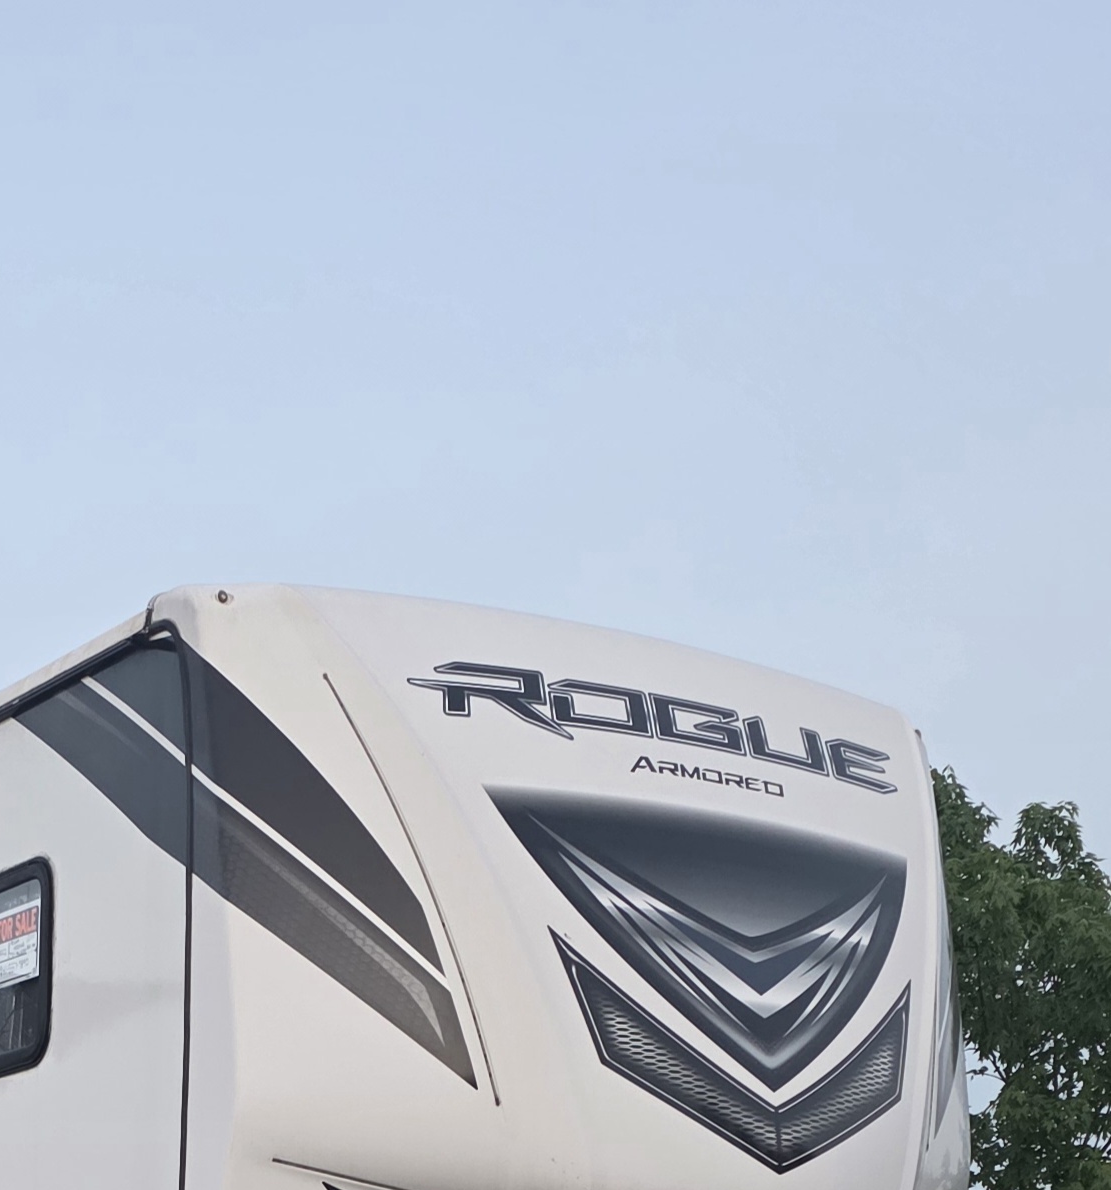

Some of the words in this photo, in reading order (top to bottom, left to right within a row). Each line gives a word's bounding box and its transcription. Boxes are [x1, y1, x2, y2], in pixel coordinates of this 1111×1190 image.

[406, 661, 898, 795] ROGUE
[630, 755, 785, 798] ARMORED
[15, 907, 37, 937] SALE
